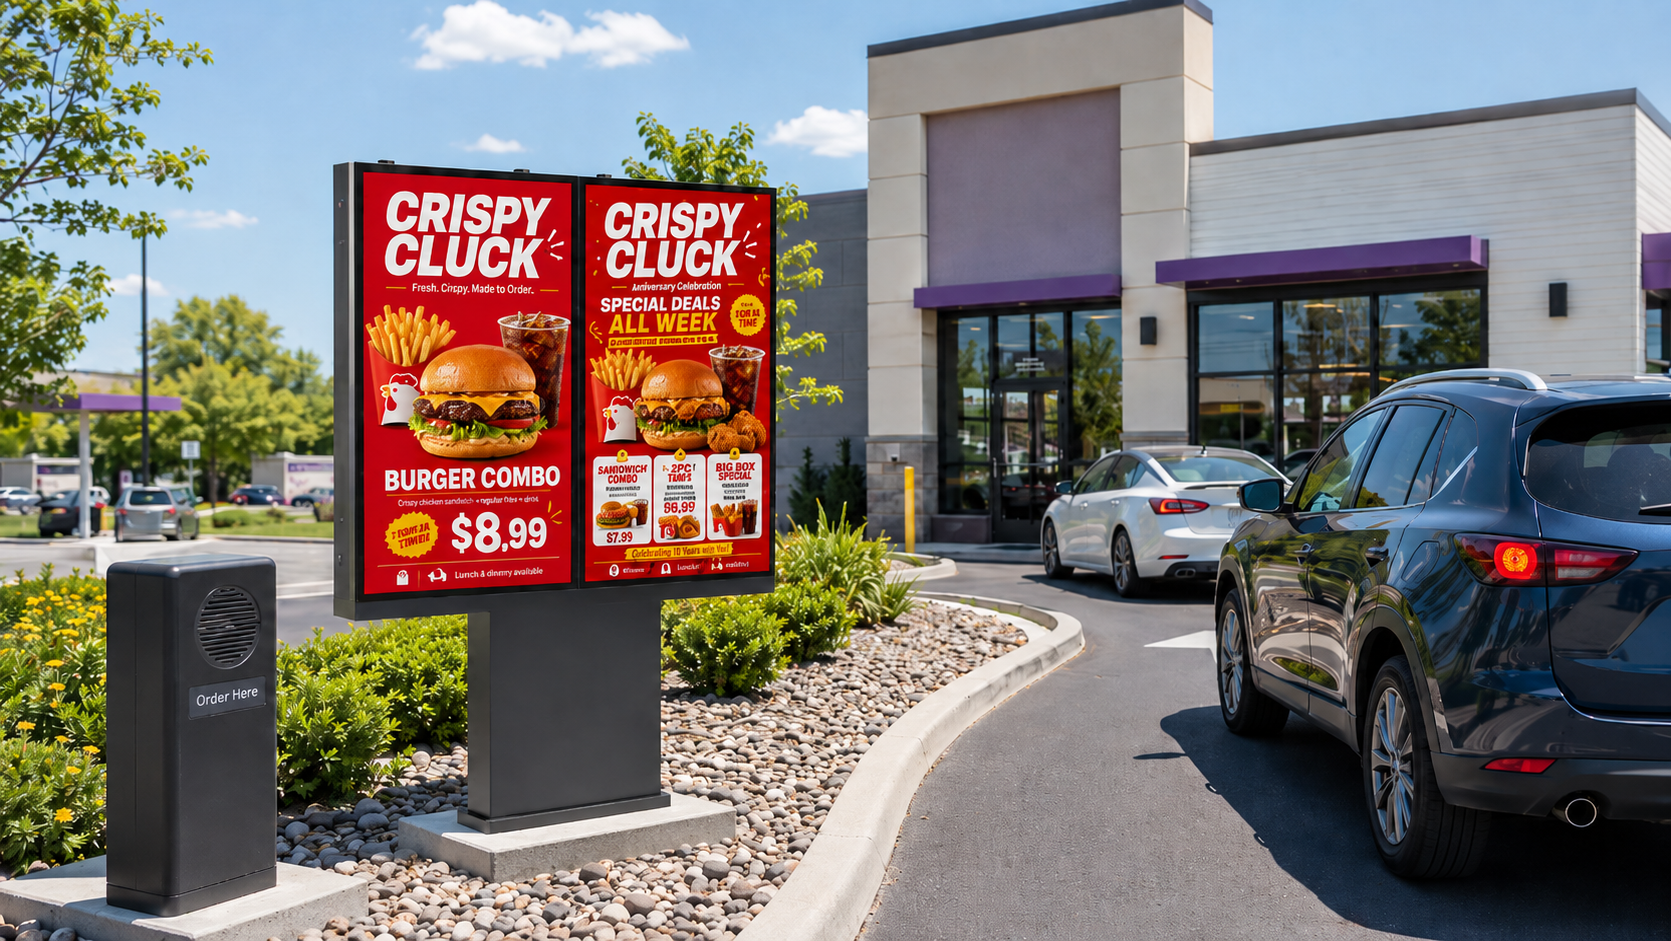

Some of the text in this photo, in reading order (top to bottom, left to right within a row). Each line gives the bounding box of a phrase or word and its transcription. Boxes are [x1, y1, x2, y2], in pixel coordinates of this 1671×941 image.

[386, 190, 552, 236] CRISPY
[604, 202, 745, 240] CRISPY
[384, 233, 545, 279] CLUCK
[605, 240, 742, 279] CLUCK
[412, 283, 440, 293] Fresh.
[471, 283, 496, 294] Made
[496, 284, 506, 294] to
[507, 284, 535, 295] Order.
[676, 281, 722, 291] Celebration
[600, 295, 721, 313] SPECIAL DEALS
[608, 311, 718, 335] ALL WEEK
[715, 461, 756, 473] BIG BOX
[384, 465, 561, 491] BURGER COMBO
[606, 531, 633, 544] $7.99
[454, 570, 479, 579] Lunch
[196, 687, 259, 707] Order Here
